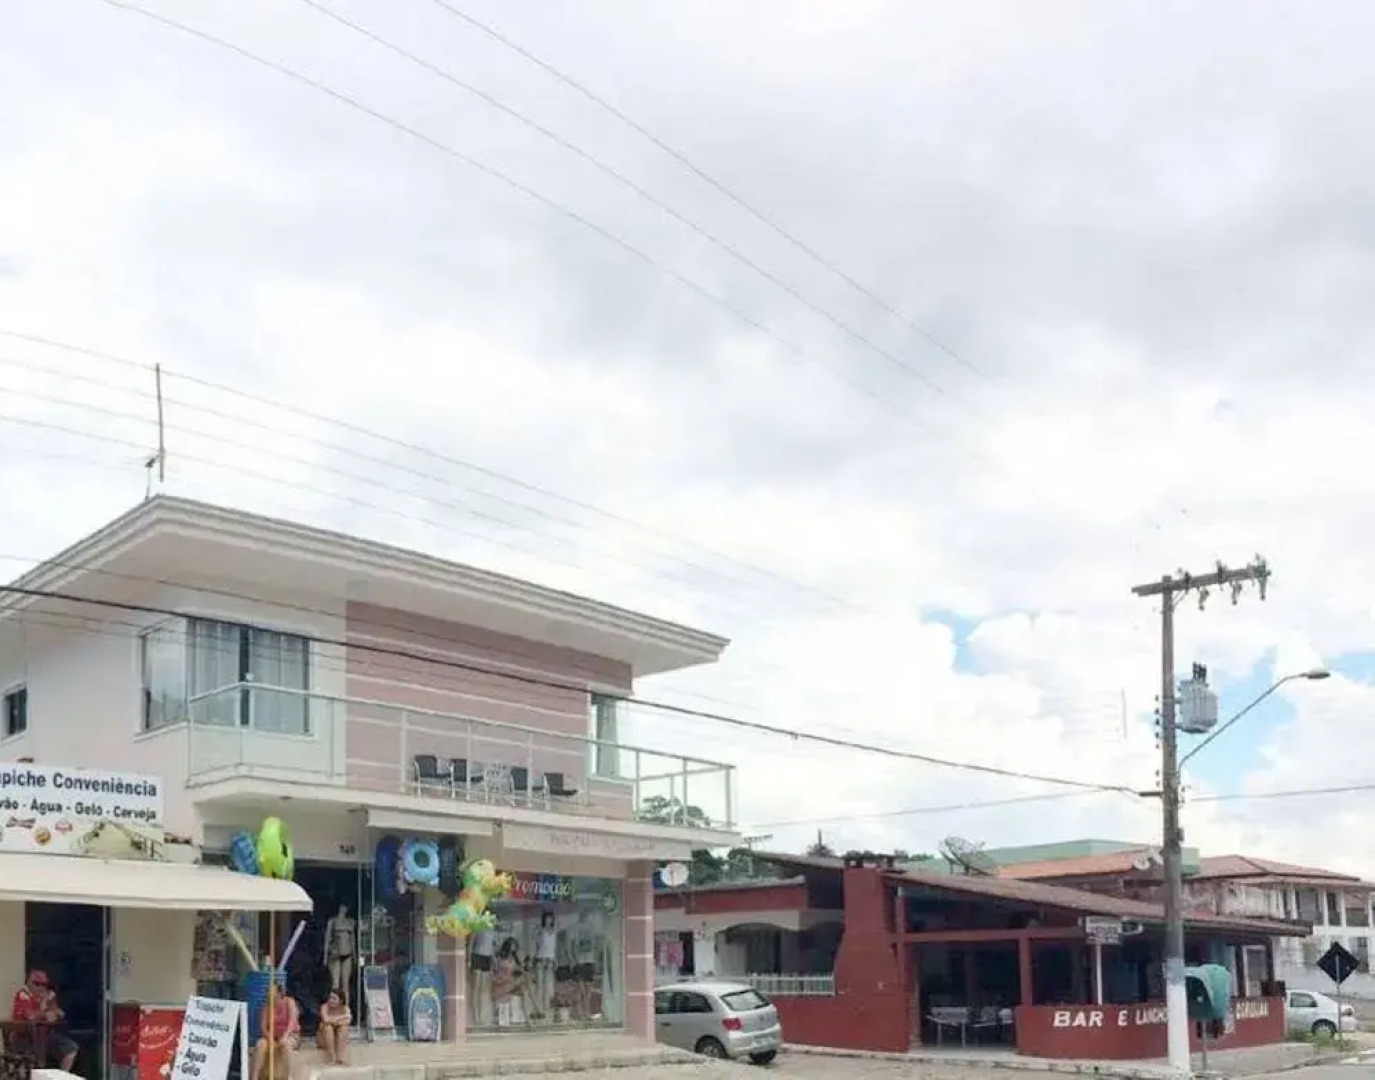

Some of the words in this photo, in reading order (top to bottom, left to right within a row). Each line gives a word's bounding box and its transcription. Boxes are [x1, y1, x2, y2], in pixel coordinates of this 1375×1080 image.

[53, 772, 157, 797] Conveniência
[30, 798, 62, 815] Água
[75, 802, 103, 817] Gelo
[113, 806, 156, 822] Cerveja
[1053, 1011, 1104, 1027] BAR
[1118, 1010, 1128, 1026] E
